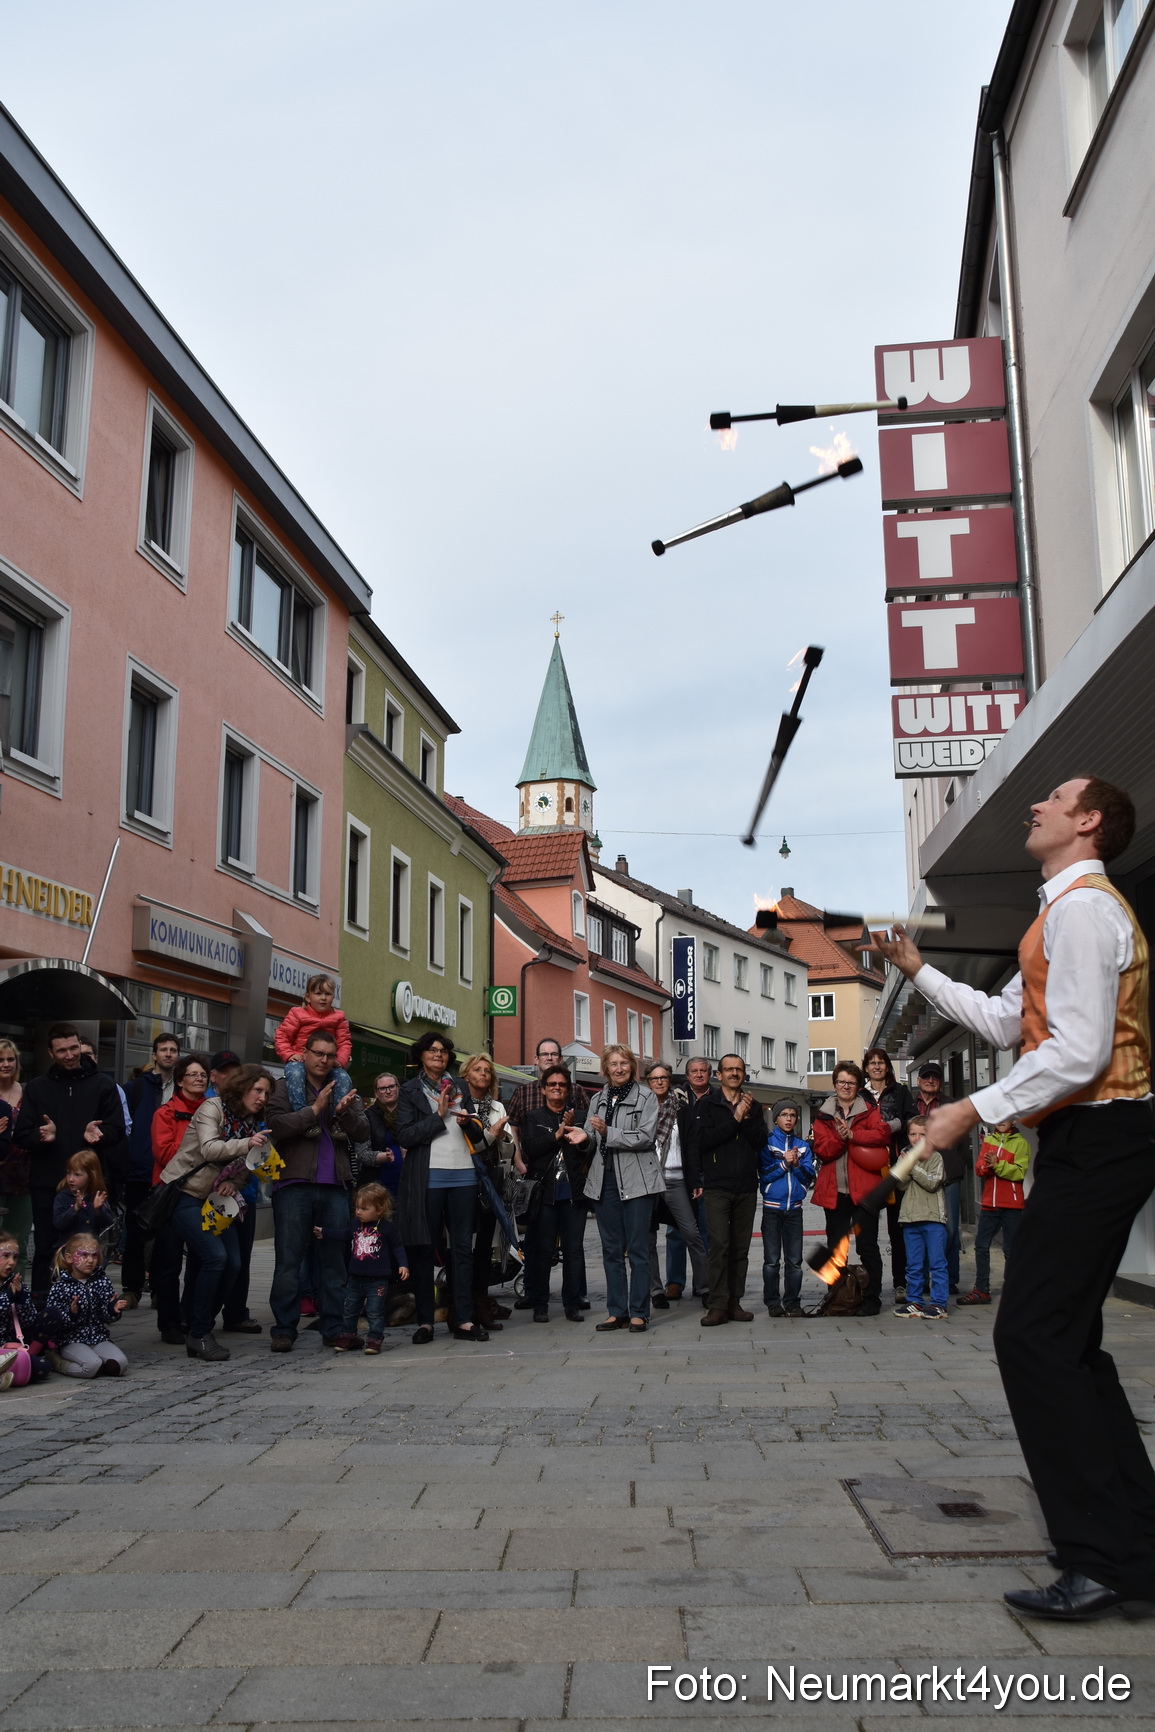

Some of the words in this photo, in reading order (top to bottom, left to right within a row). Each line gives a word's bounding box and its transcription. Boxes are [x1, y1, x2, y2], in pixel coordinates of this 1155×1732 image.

[883, 346, 976, 670] WITT
[898, 693, 1020, 735] WITT
[150, 917, 244, 970] KOMMUNIKATION
